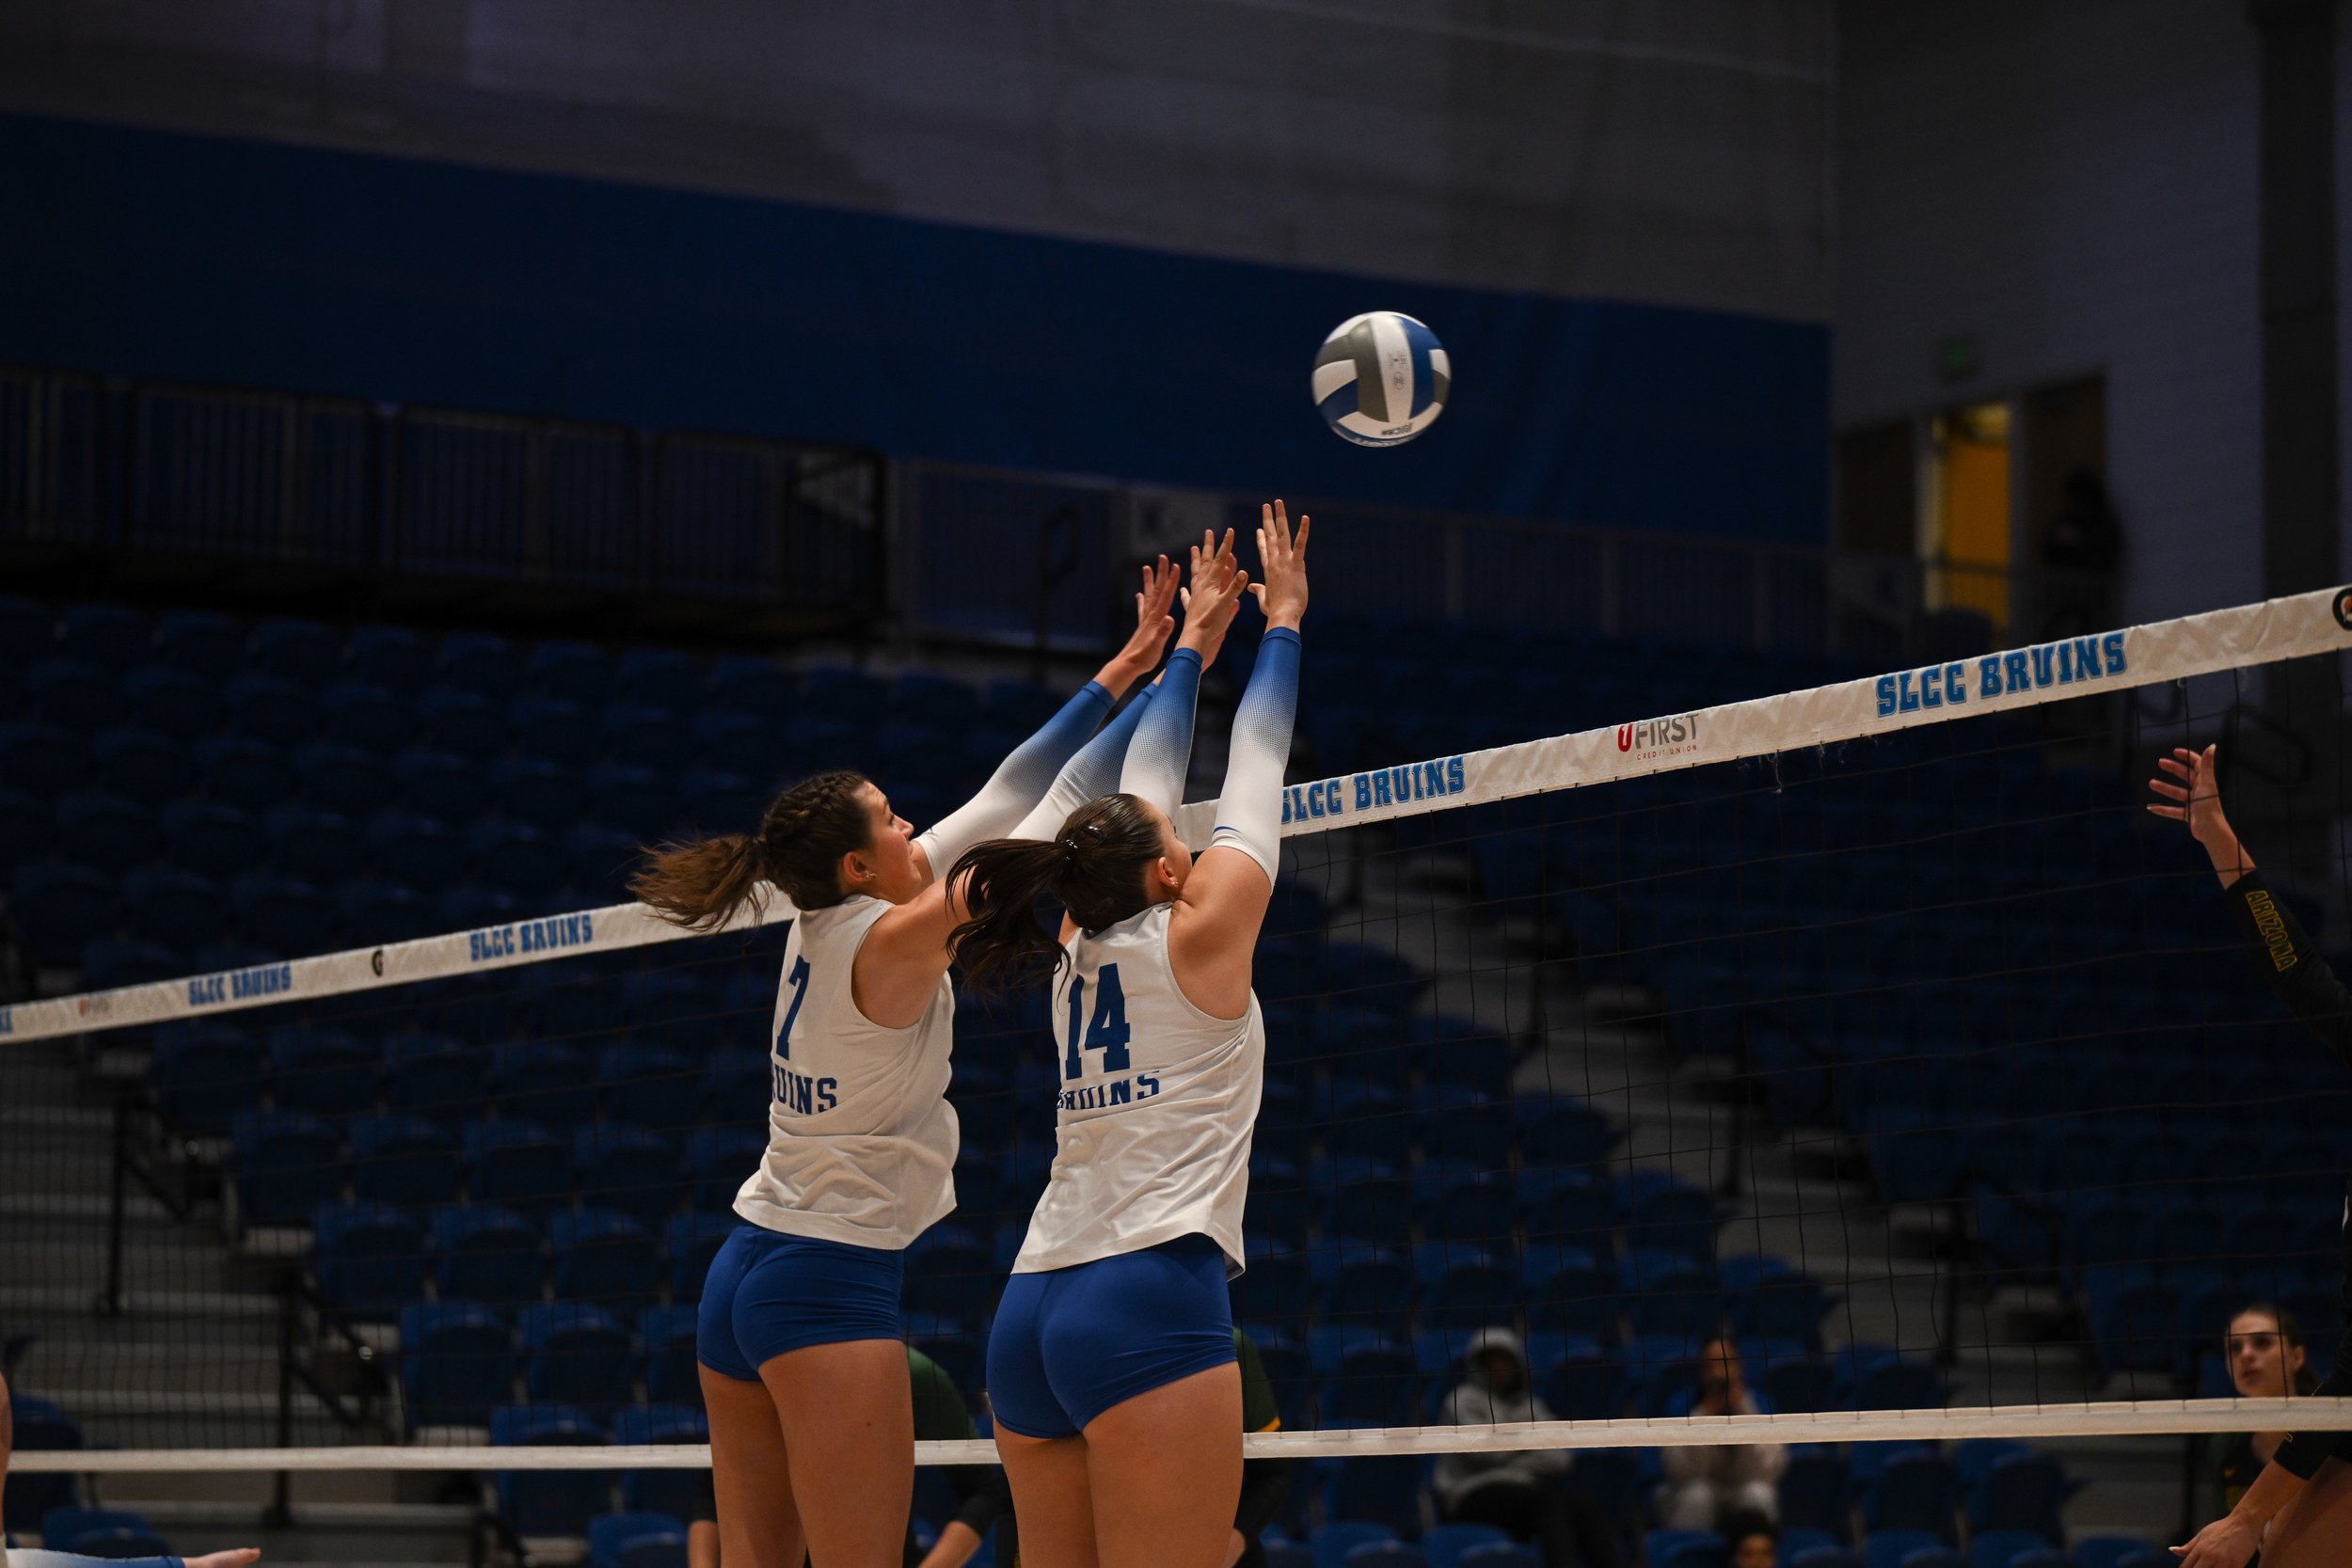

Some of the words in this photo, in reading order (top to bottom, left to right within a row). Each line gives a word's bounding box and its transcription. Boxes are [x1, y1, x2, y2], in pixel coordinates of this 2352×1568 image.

[1876, 663, 1966, 717] SLCC
[1979, 632, 2128, 699] BRUINS
[1617, 713, 1699, 752] UFIRST
[1281, 779, 1343, 824] SLCC
[1353, 755, 1465, 811] BRUINS
[470, 923, 516, 961] SLCC
[520, 913, 594, 953] BRUINS
[2244, 890, 2297, 973] ARIZONA
[775, 954, 811, 1061] 7
[1065, 962, 1131, 1080] 14
[772, 1063, 837, 1116] UINS
